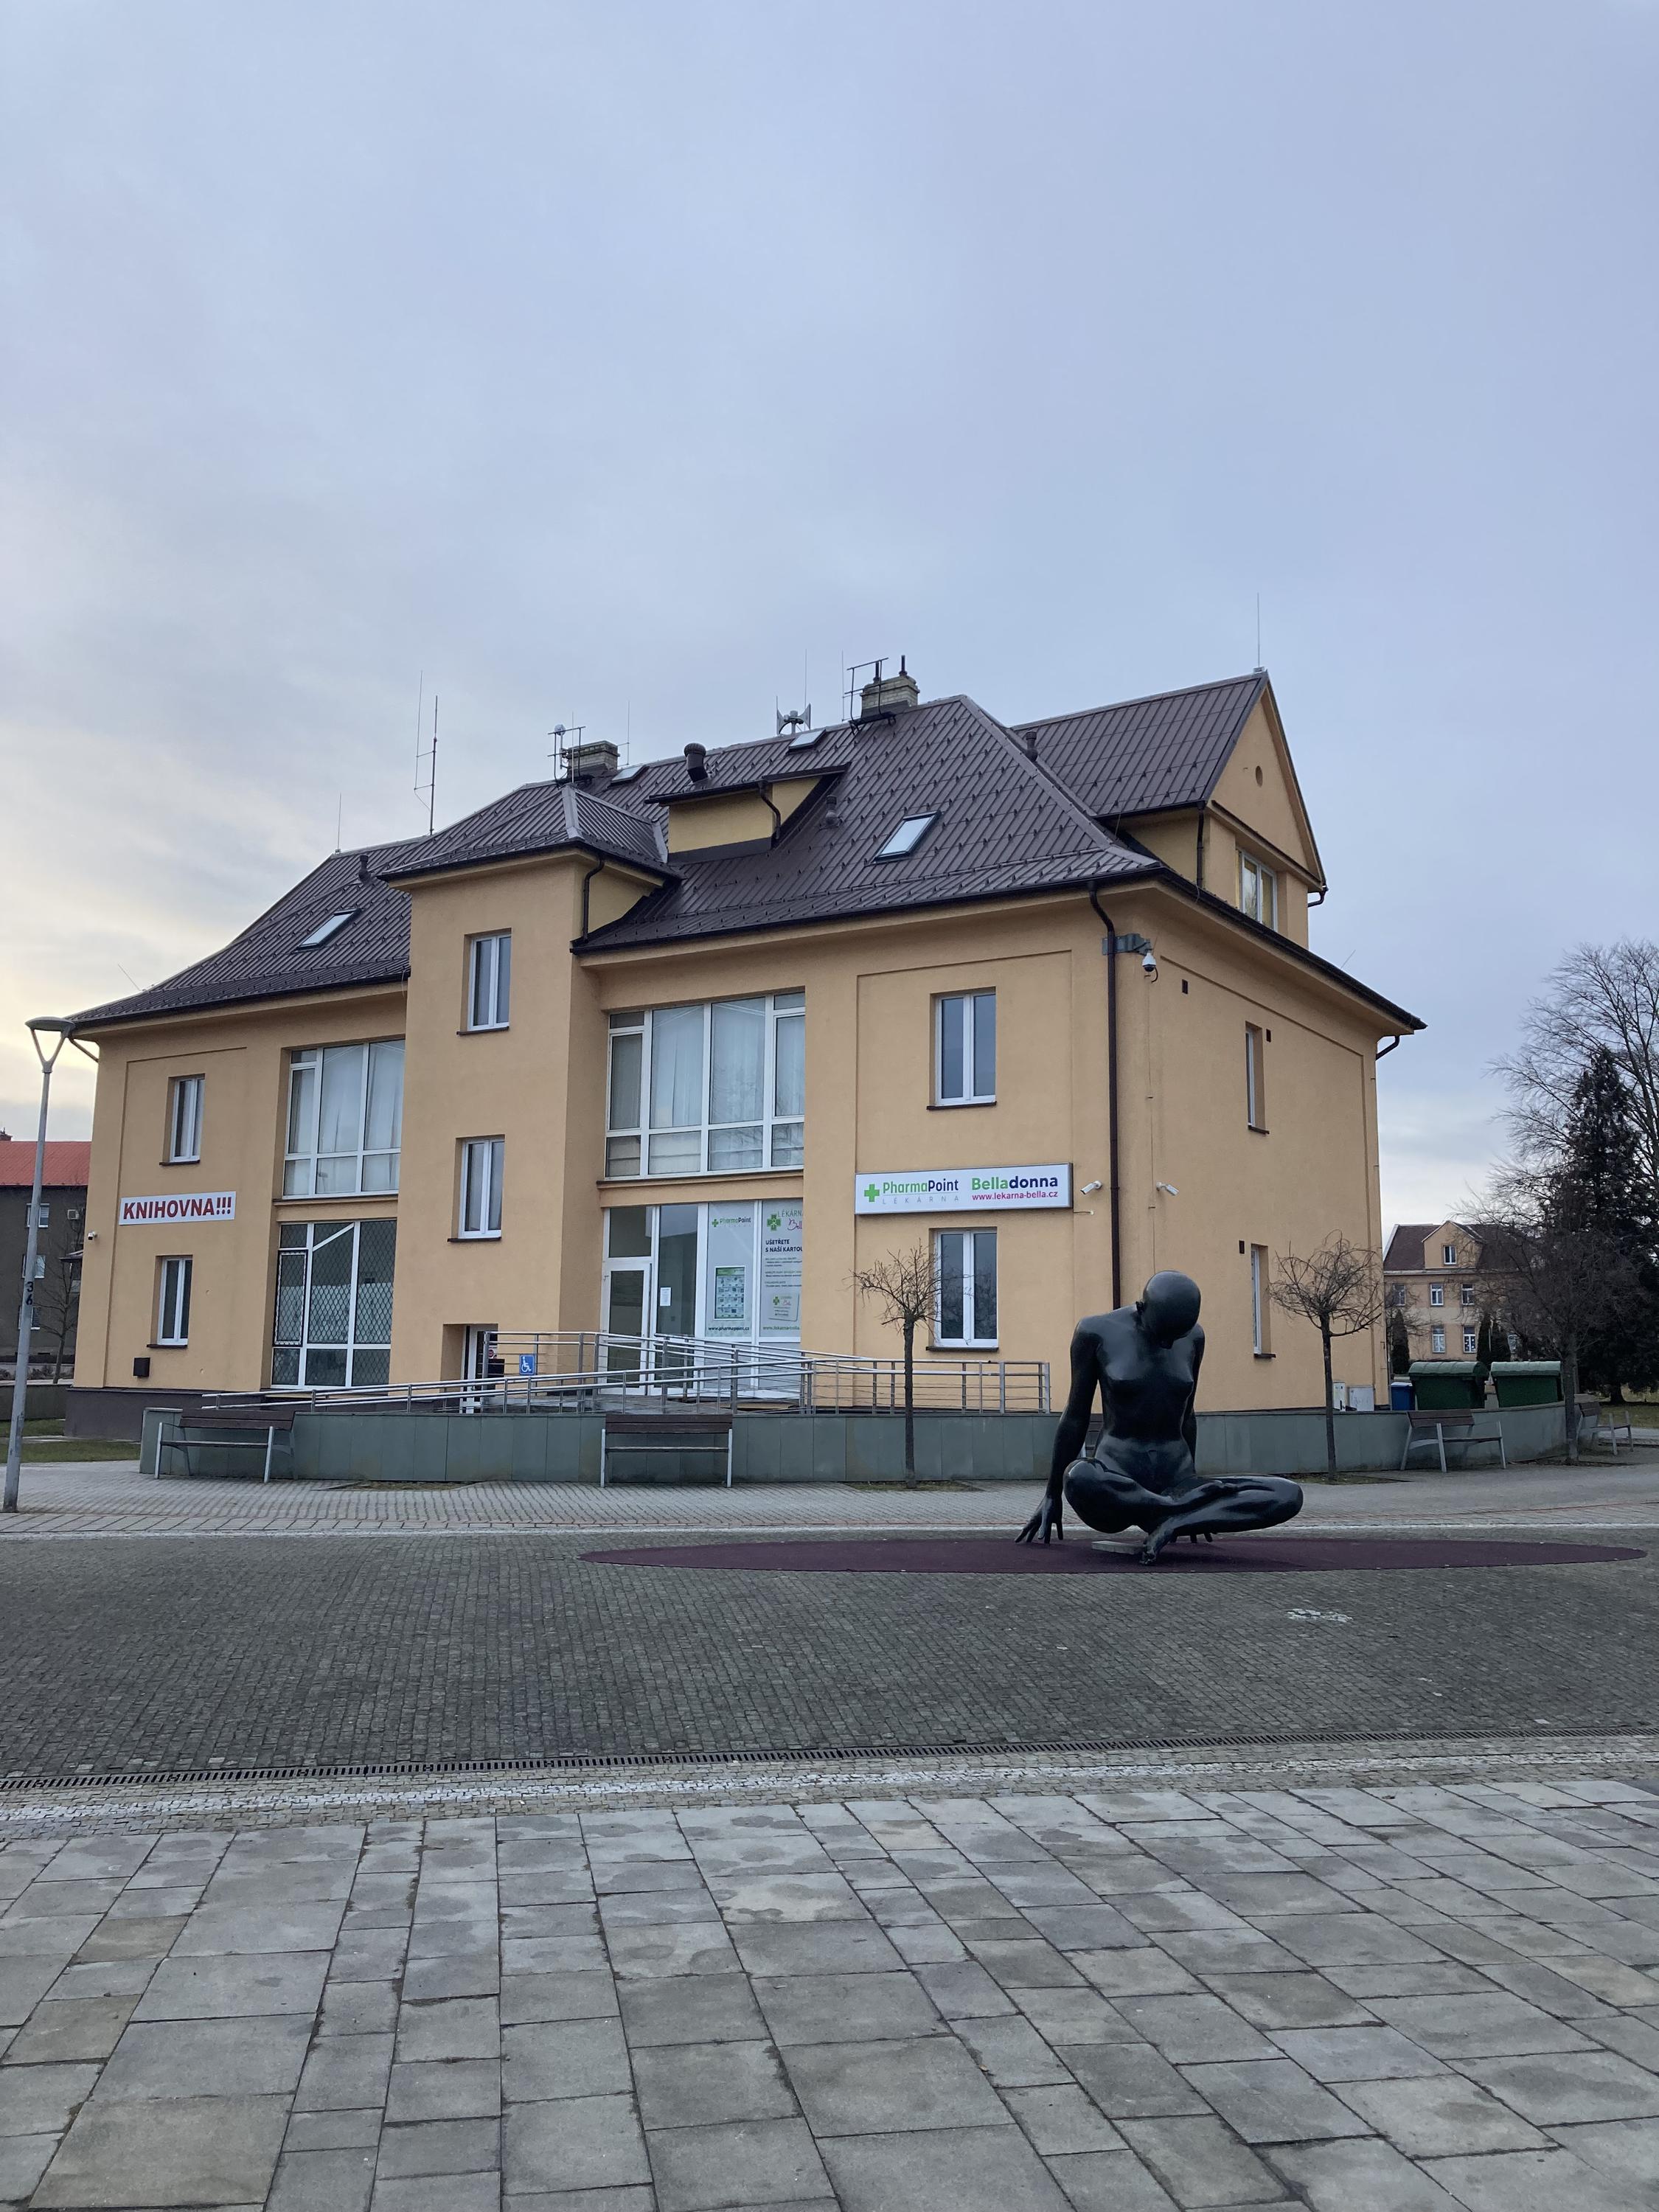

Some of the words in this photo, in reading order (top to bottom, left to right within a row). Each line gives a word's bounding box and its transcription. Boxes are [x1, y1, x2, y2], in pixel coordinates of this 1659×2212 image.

[883, 1178, 959, 1194] PharmaPoint
[972, 1175, 1059, 1191] Belladonna
[972, 1190, 1059, 1201] www.lekarna-bella.cz
[123, 1197, 232, 1220] KNIHOVNA!!!
[777, 1208, 803, 1217] LÉKÁRN
